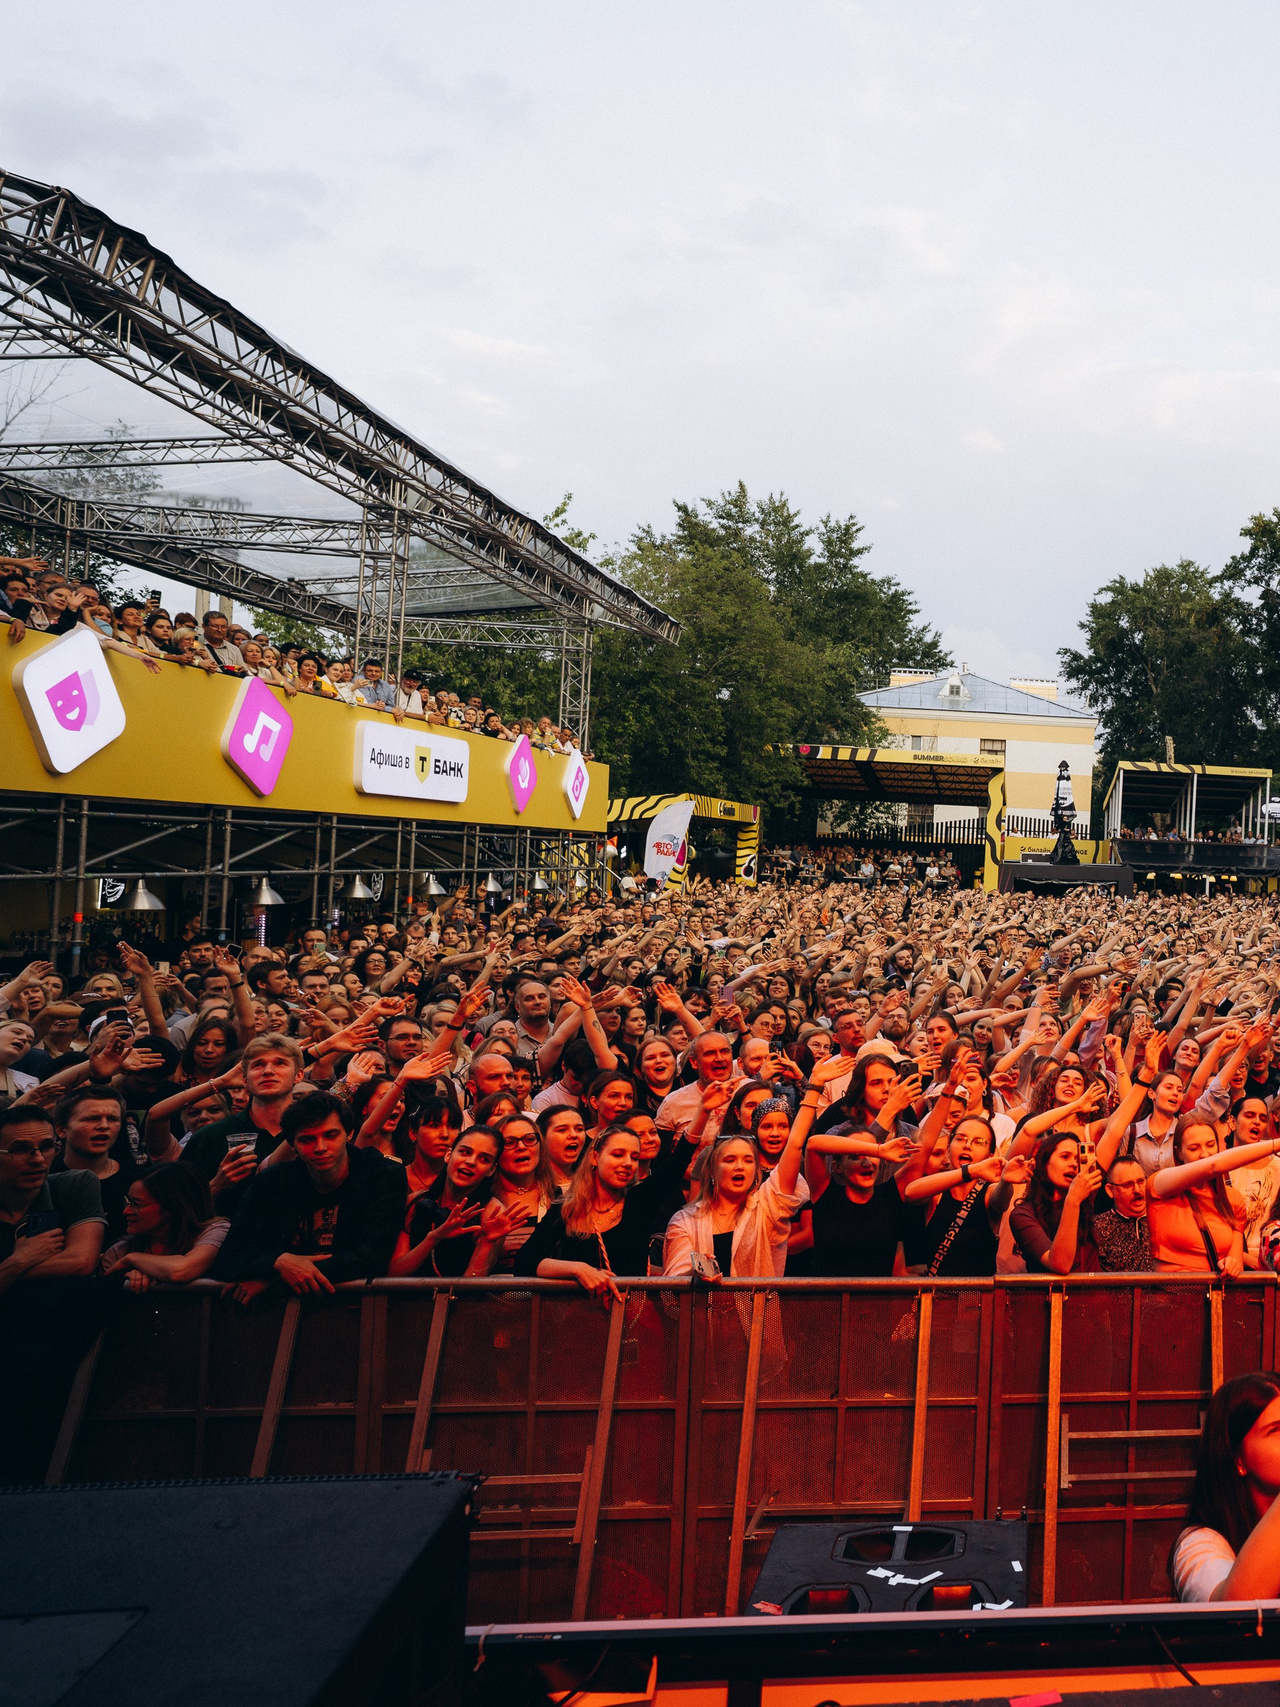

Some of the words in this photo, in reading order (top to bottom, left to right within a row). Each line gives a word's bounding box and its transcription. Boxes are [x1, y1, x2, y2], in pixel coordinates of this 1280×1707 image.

[370, 748, 403, 769] Афиша
[405, 756, 410, 769] в
[434, 758, 464, 778] БАНК
[652, 842, 673, 850] АВТО
[1027, 846, 1051, 854] билайн
